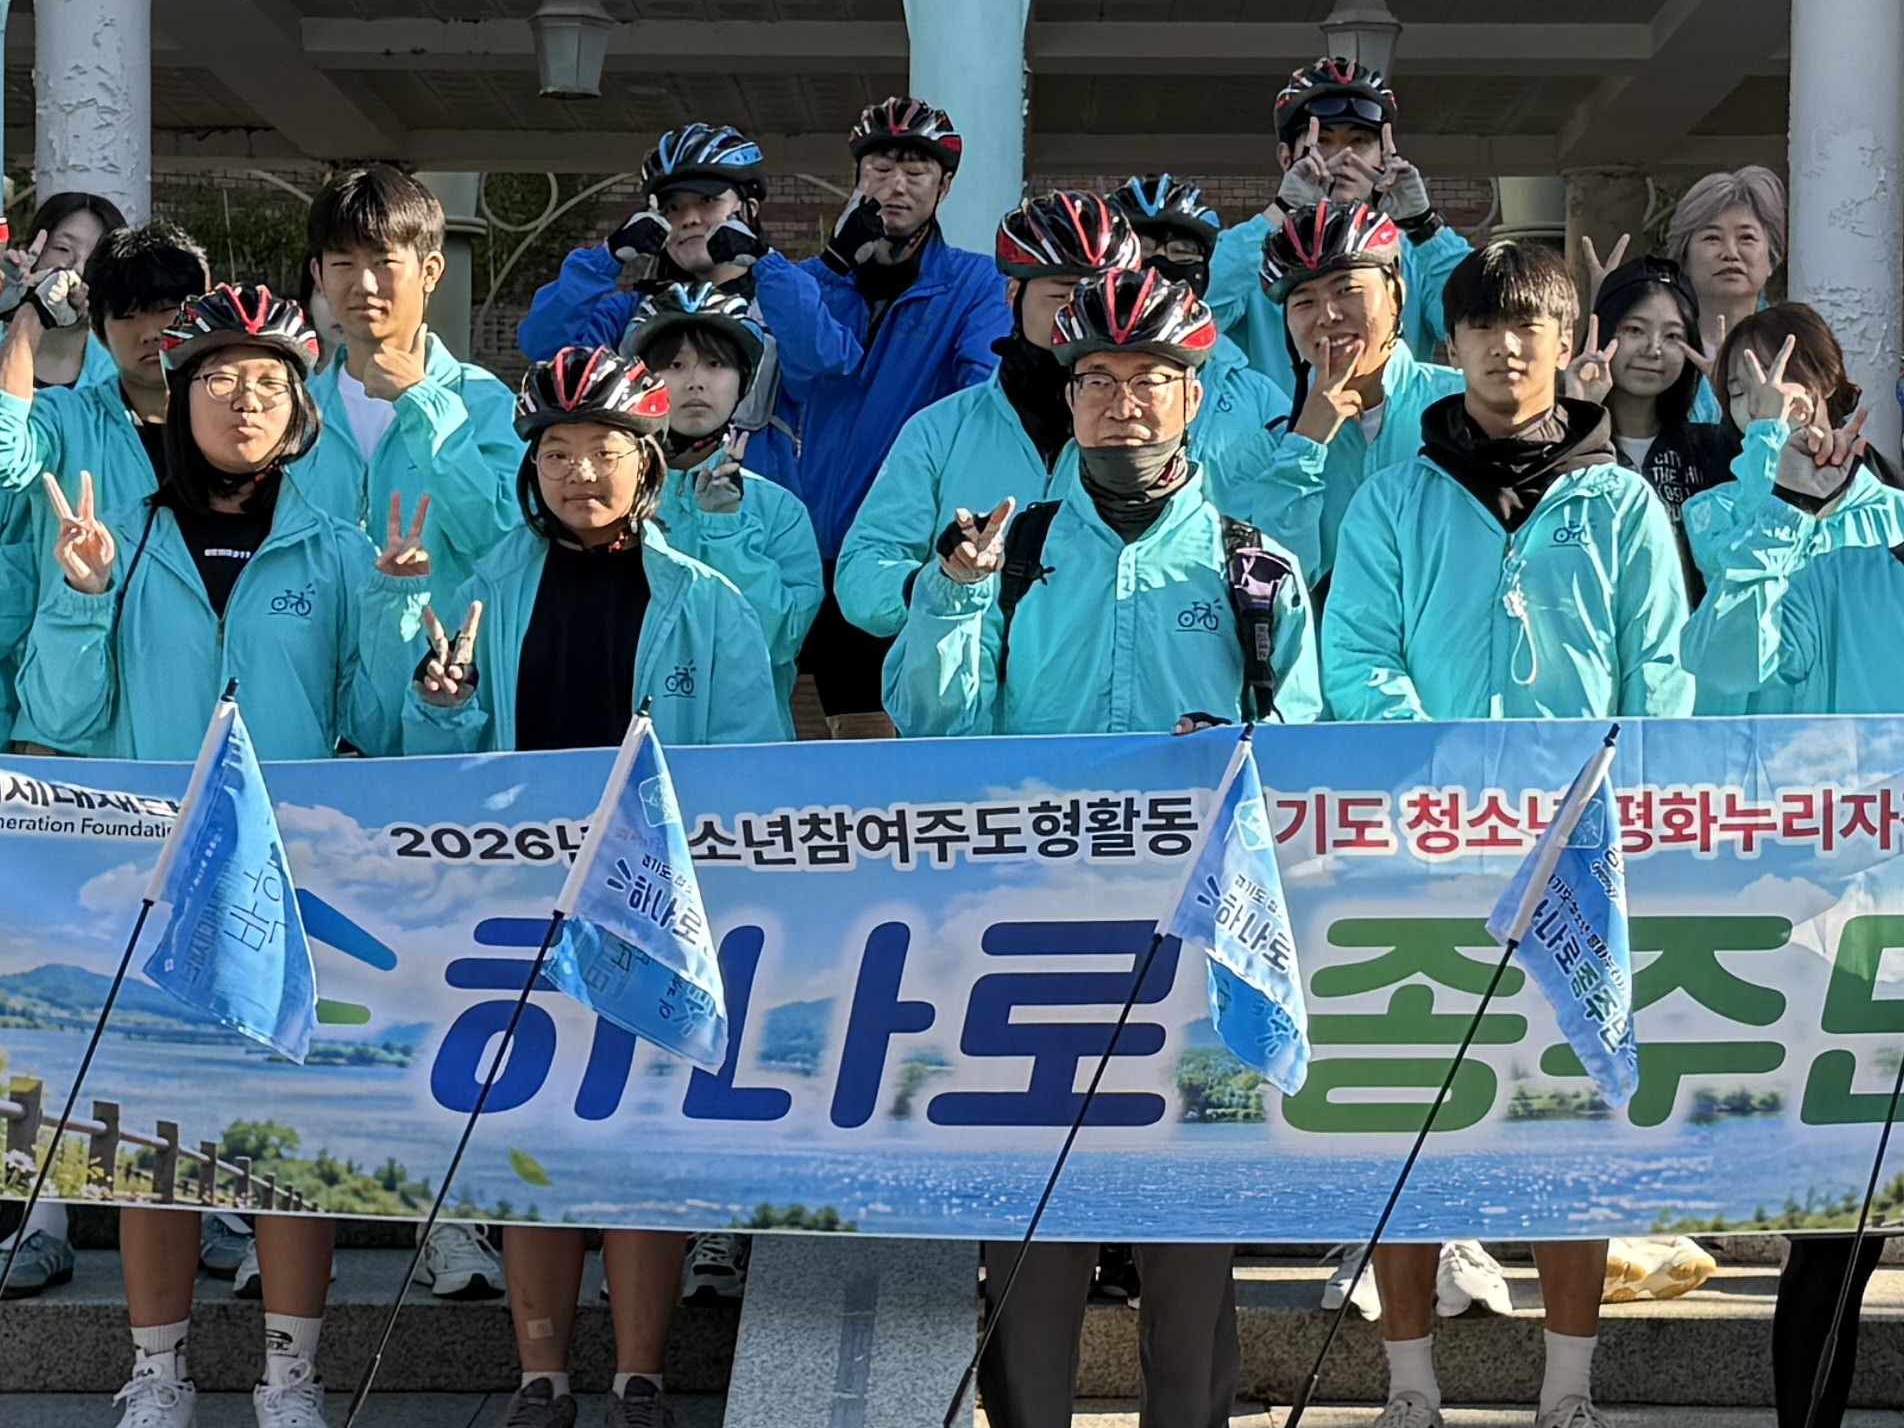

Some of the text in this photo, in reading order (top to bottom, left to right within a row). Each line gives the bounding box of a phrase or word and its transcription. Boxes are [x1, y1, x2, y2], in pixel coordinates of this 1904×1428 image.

[80, 817, 175, 839] Foundati
[688, 796, 1202, 868] 소년참여주도형활동
[1274, 793, 1390, 857] 기도
[430, 916, 1183, 1129] 하나로
